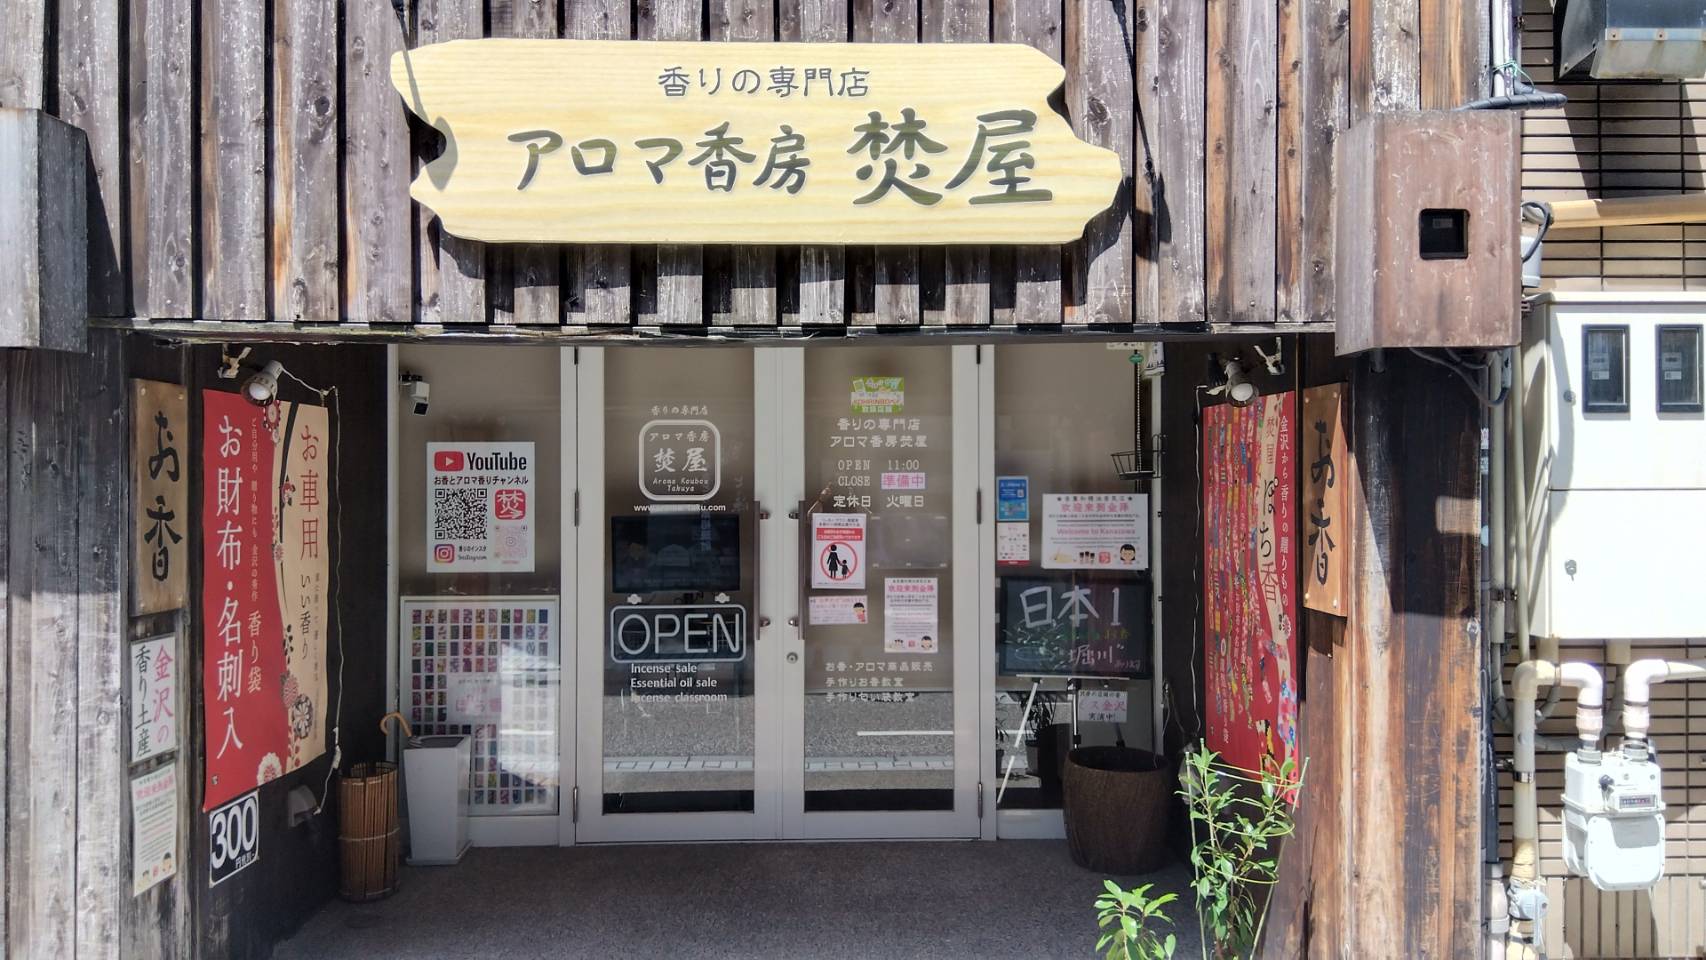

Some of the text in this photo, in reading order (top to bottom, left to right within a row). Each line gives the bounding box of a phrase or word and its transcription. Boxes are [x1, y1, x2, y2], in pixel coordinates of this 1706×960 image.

[657, 66, 871, 97] 香りの専門店
[507, 106, 1054, 206] アロマ香房 焚屋
[651, 405, 709, 415] 香りの専門店
[837, 418, 921, 431] 香りの専門店
[649, 431, 711, 442] アロマ香房
[466, 451, 528, 471] YouTube
[653, 447, 708, 473] 焚屋
[837, 459, 920, 470] OPEN 11:00
[433, 475, 529, 485] お香とアロマ香りチャンネル
[837, 474, 924, 488] CLOSE 準備中
[299, 424, 320, 561] お車用
[667, 485, 695, 493] Takuya
[833, 495, 924, 508] 定休日 火曜日
[216, 415, 244, 760] お財布・名刺入
[300, 573, 312, 661] いい香り
[617, 613, 740, 655] OPEN
[247, 609, 262, 694] 香り袋
[631, 663, 698, 674] Incense sale
[825, 661, 933, 672] お香・アロマ商品販売
[630, 677, 718, 688] Essential oil sale
[825, 677, 904, 687] 手作りお香教室
[153, 644, 174, 743] 金沢の
[674, 691, 728, 702] classroom
[135, 644, 152, 758] 香り土産
[211, 797, 257, 870] 300
